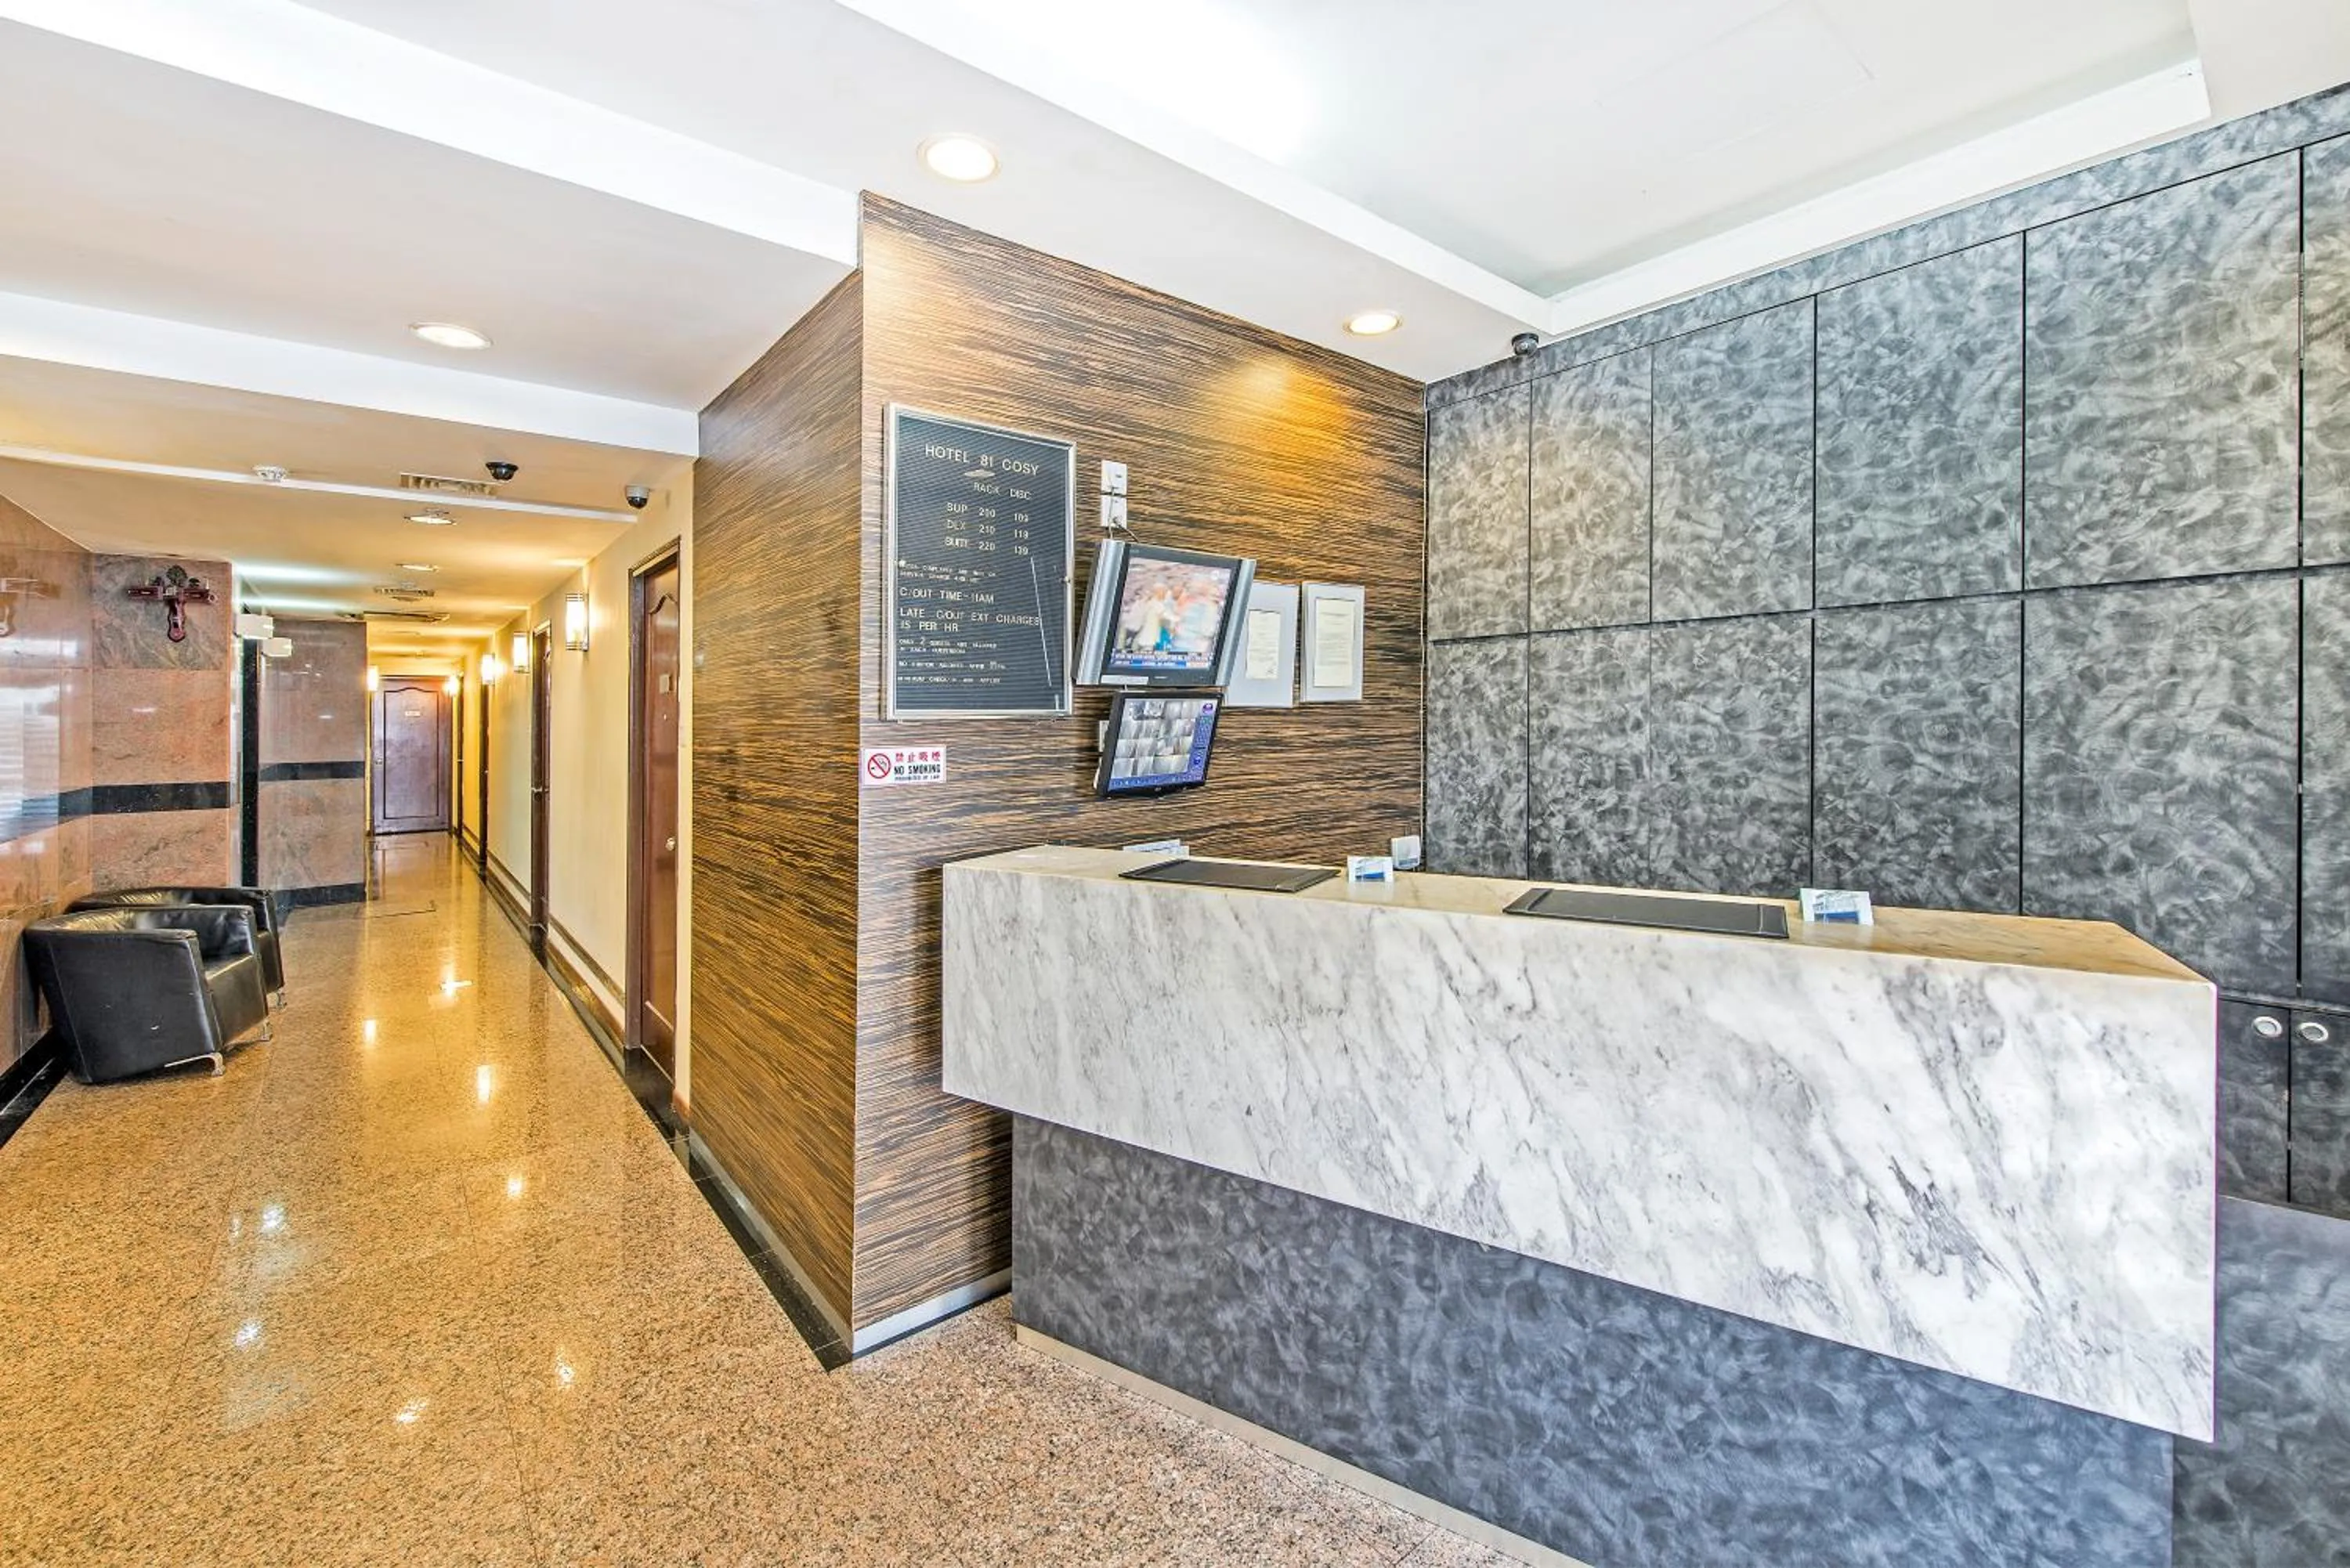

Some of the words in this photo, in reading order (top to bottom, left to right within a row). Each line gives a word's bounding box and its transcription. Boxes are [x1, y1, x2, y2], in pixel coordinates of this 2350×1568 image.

[925, 443, 970, 463] HOTEL
[1002, 458, 1039, 475] COSY
[946, 502, 967, 513] SUP
[900, 608, 925, 618] LATE
[971, 612, 989, 623] EXT
[995, 615, 1040, 626] CHARGES
[919, 621, 937, 630] PER
[944, 623, 958, 632] HR
[894, 765, 905, 775] NO
[908, 764, 941, 775] SMOKING
